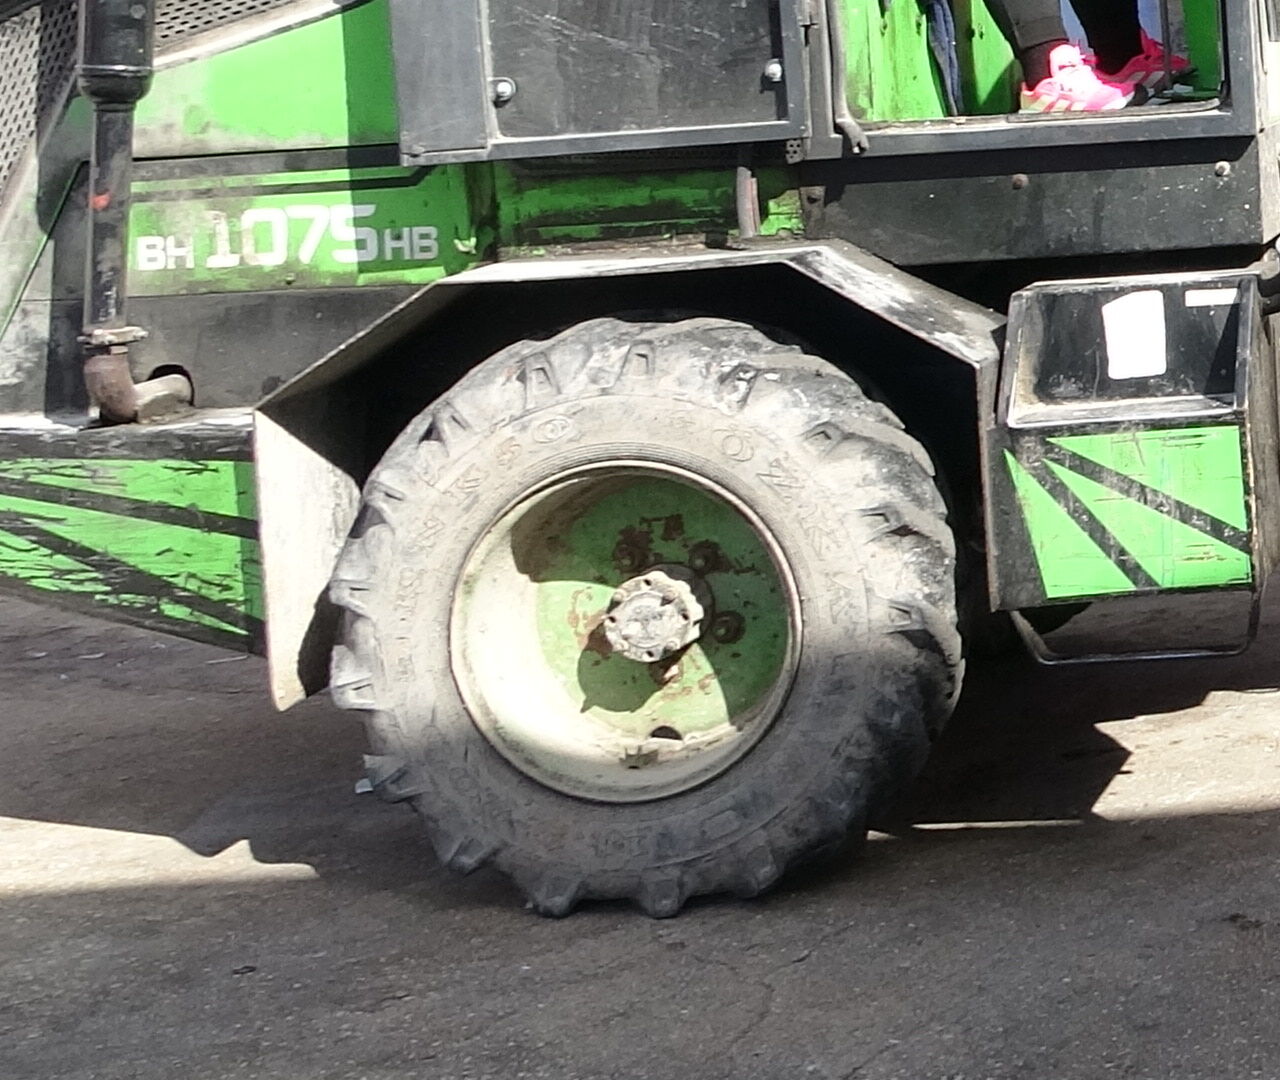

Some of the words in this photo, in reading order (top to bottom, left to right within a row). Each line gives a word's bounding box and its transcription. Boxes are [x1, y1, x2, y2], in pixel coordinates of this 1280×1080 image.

[136, 235, 195, 271] BH
[204, 203, 378, 268] 1075
[383, 226, 439, 261] HB
